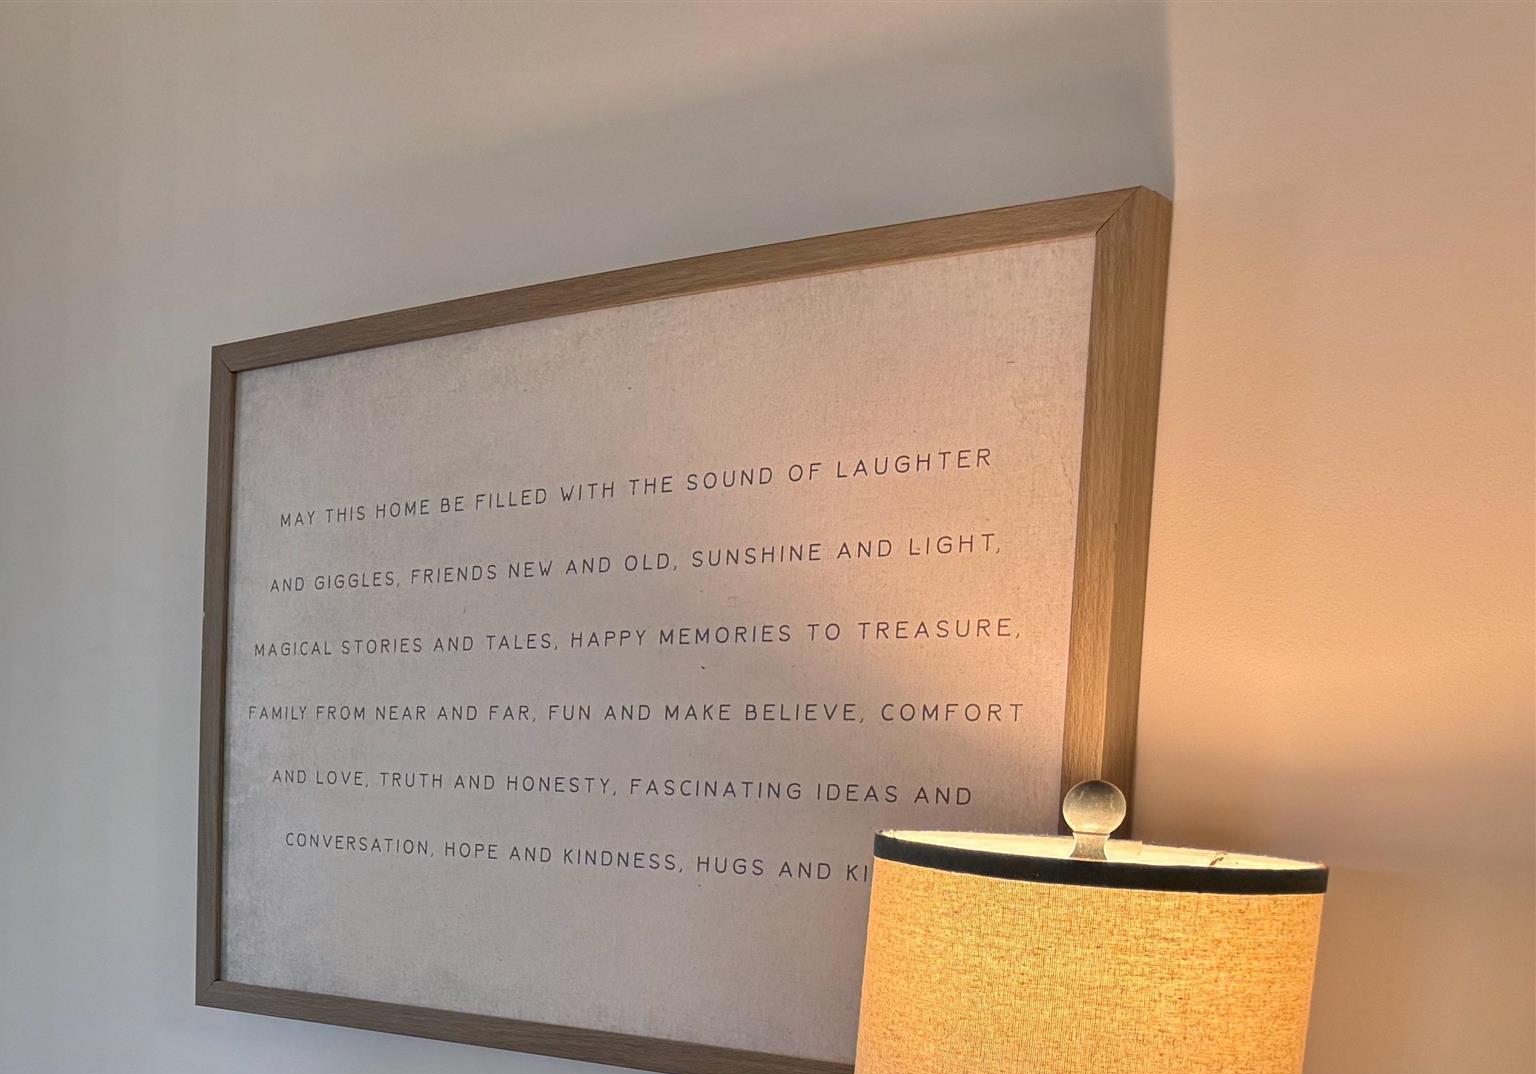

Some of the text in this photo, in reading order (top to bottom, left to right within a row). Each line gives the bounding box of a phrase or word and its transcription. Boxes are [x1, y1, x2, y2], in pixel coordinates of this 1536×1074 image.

[280, 447, 991, 528] MAY THIS HOME BE FILLED WITH THE SOUND OF LAUGHTER
[270, 532, 1001, 593] AND GIGGLES, FRIENDS NEW AND OLD, SUNSHINE AND LIGHT,
[254, 617, 1020, 657] MAGICAL STORIES AND TALES, HAPPY MEMORIES TO TREASURE,
[248, 703, 1024, 724] FAMILY FROM NEAR AND FAR, FUN AND MAKE BELIEVE, COMFORT
[272, 769, 972, 806] AND LOVE, TRUTH AND HONESTY, FASCINATING IDEAS AND
[285, 832, 435, 858] CONVERSATION,
[444, 841, 498, 860] HOPE
[508, 845, 552, 863] AND
[563, 848, 683, 873] KINDNESS,
[696, 855, 764, 877] HUGS
[778, 860, 831, 880] AND
